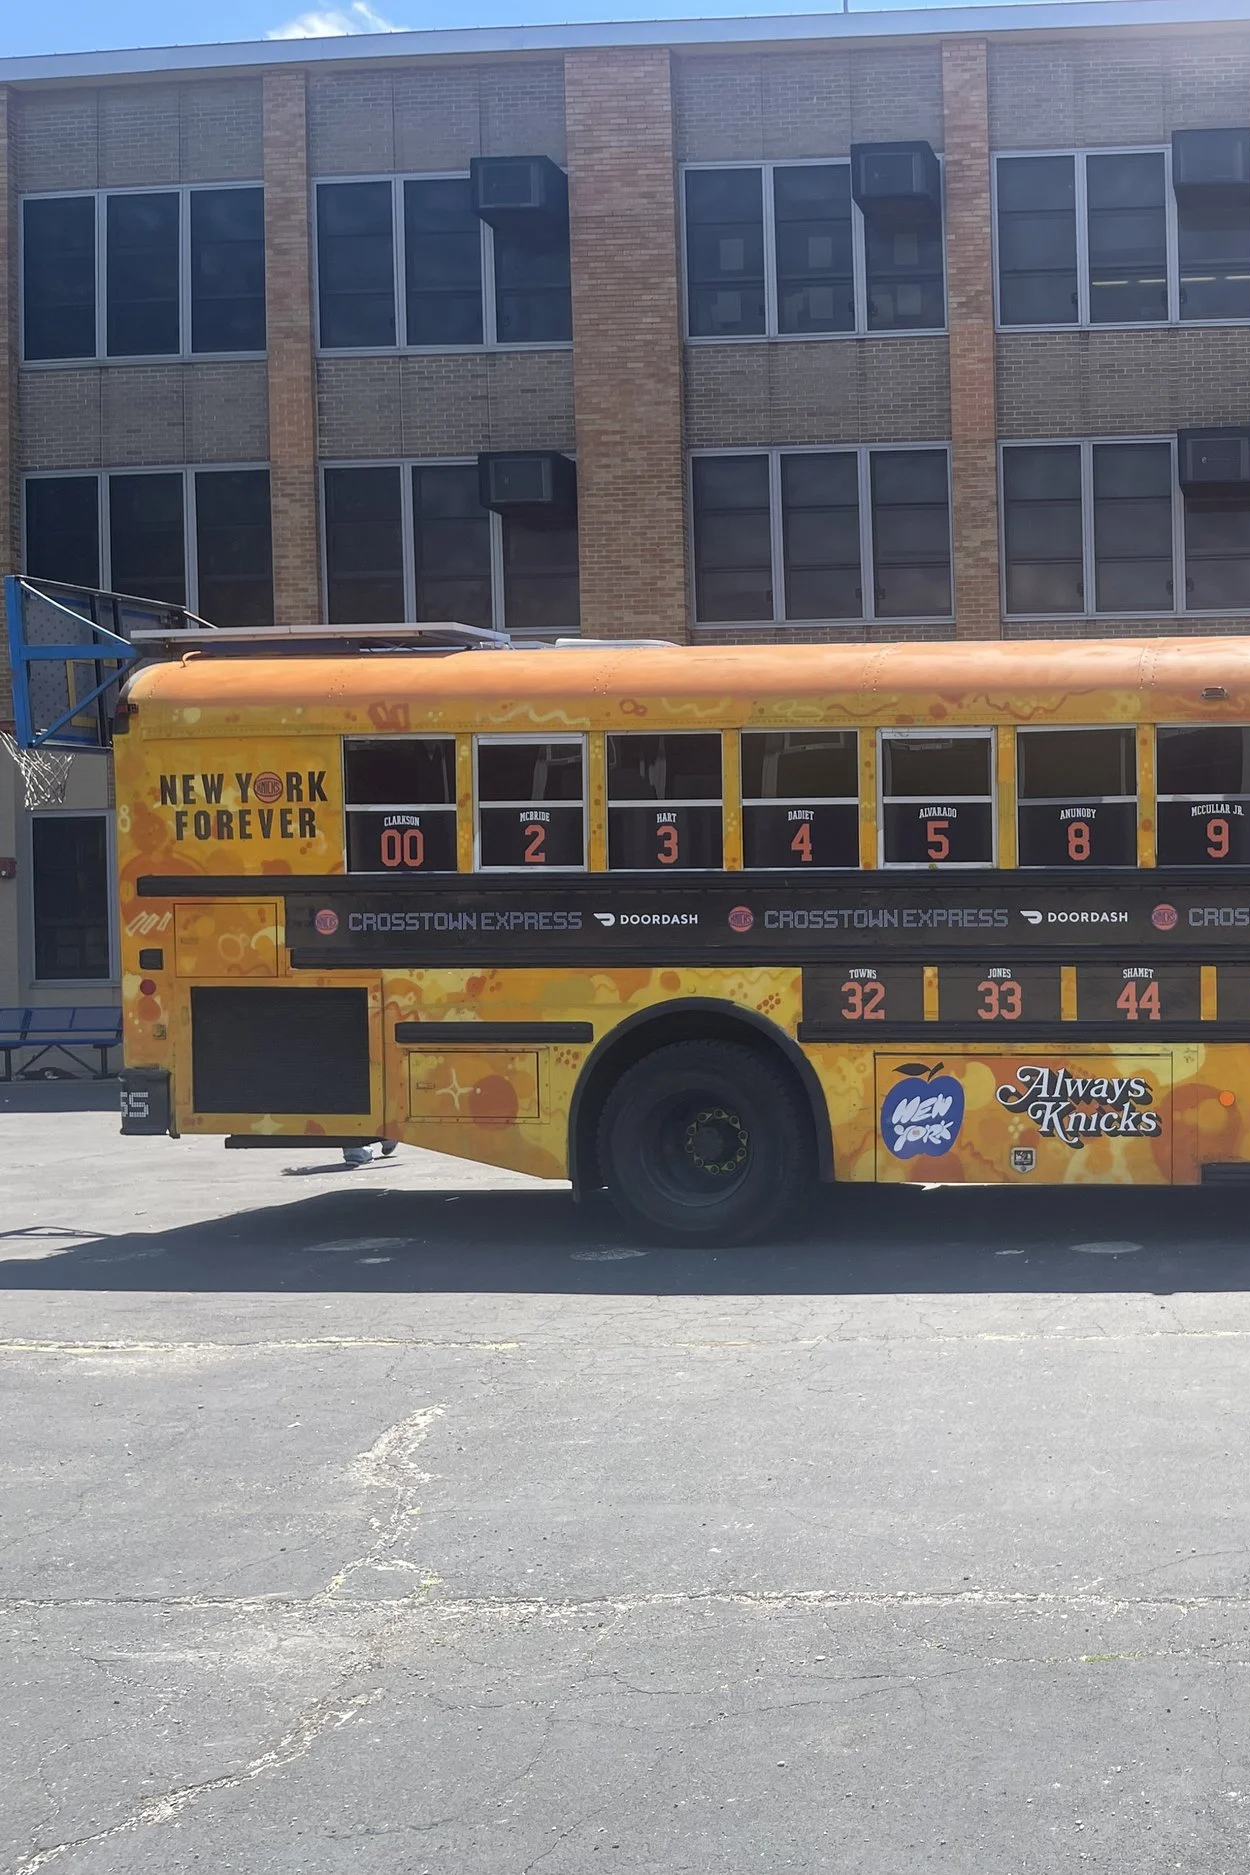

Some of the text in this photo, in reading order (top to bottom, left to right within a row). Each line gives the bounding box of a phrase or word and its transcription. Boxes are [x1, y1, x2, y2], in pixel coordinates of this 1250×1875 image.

[160, 773, 224, 805] NEW
[175, 808, 316, 840] FOREVER
[384, 815, 420, 827] CLARKSON
[519, 811, 551, 822] MCBRIDE
[656, 812, 677, 823] HART
[788, 809, 814, 821] DADIET
[918, 807, 957, 819] ALVARADO
[1059, 807, 1096, 819] ANUNOBY
[1191, 804, 1230, 816] MCCULLAR
[380, 829, 424, 867] 00
[524, 824, 546, 862] 2
[656, 825, 679, 864] 3
[791, 824, 813, 862] 4
[927, 820, 950, 860] 5
[1067, 821, 1090, 861] 8
[1206, 818, 1230, 858] 9
[349, 911, 582, 931] CROSSTOWN EXPRESS
[620, 914, 698, 925] DOORDASH
[764, 908, 1009, 929] CROSSTOWN EXPRESS
[1048, 911, 1129, 923] DOORDASH
[849, 968, 877, 979] TOWNS
[988, 968, 1011, 979] JONES
[1122, 967, 1154, 979] SHAMET
[841, 981, 885, 1020] 32
[977, 981, 1022, 1020] 33
[1116, 981, 1160, 1020] 44
[996, 1065, 1147, 1105] Always
[892, 1093, 953, 1125] NEW
[1027, 1099, 1158, 1145] Knicks
[893, 1120, 954, 1152] YORK
